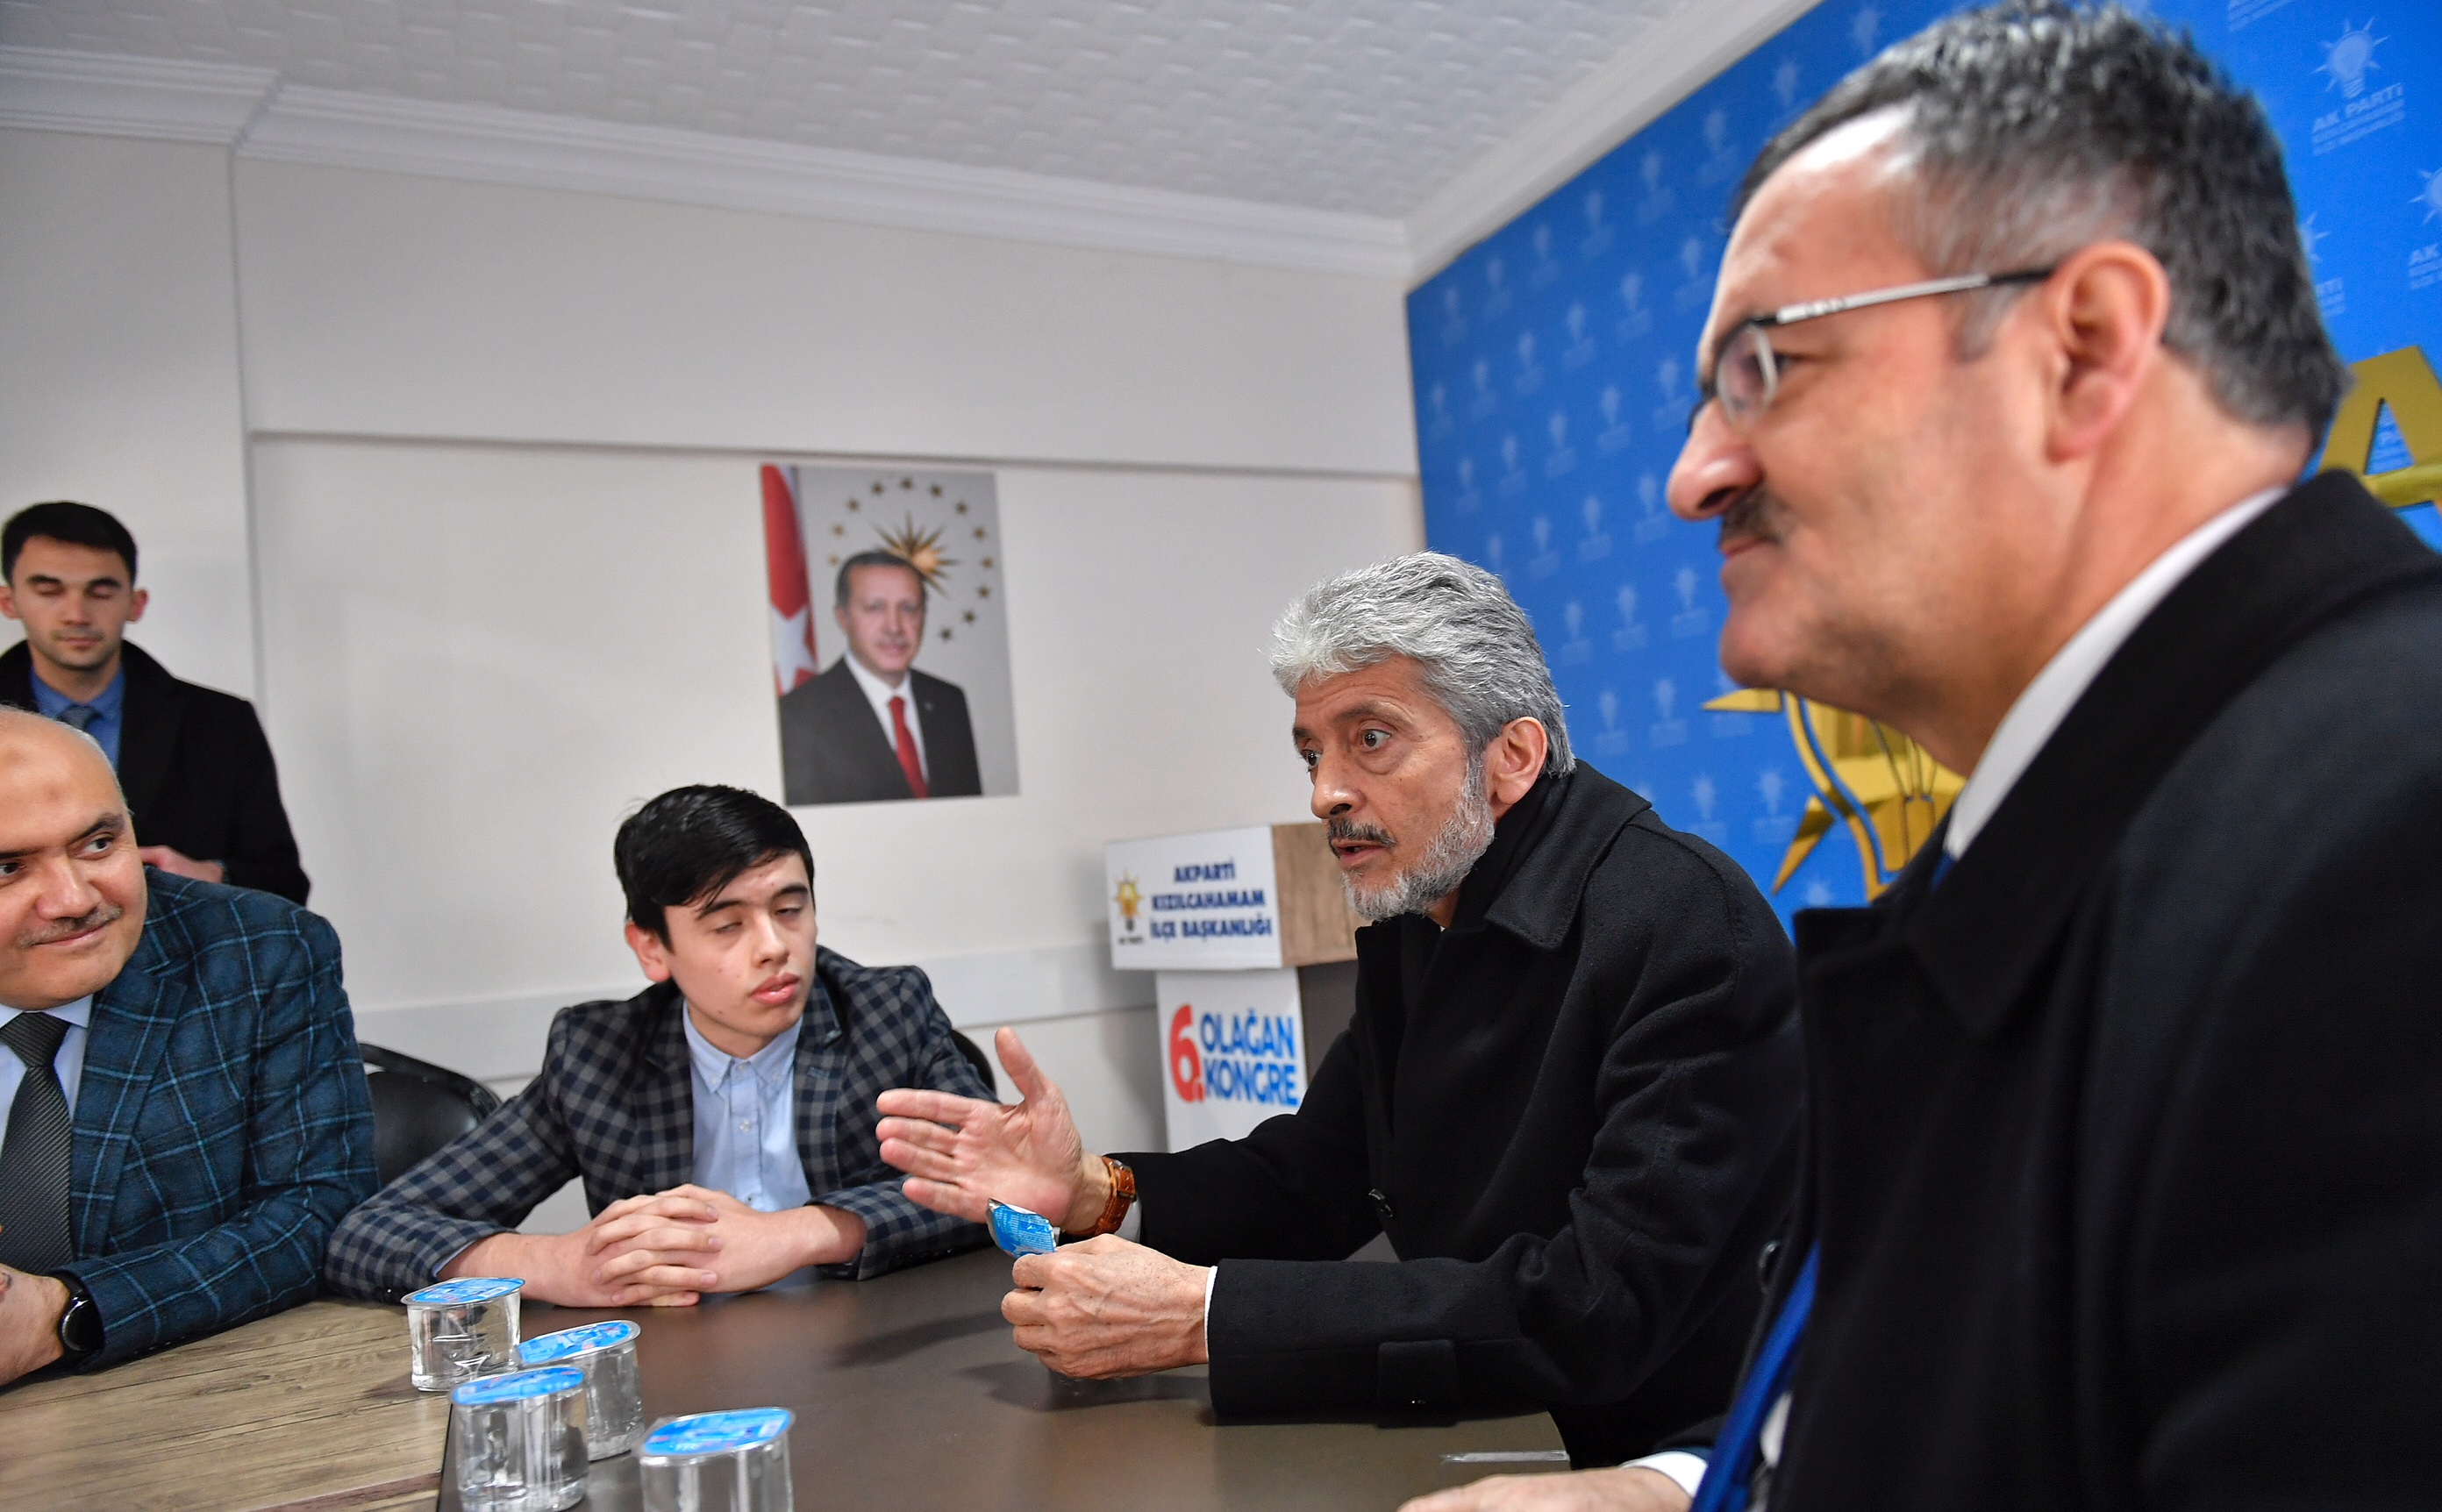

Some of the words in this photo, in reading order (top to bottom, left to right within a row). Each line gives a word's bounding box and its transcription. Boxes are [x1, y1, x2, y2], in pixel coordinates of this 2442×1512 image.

[2311, 111, 2340, 134] AK
[1152, 889, 1266, 910] KIZILCAHAMAM
[1201, 1008, 1296, 1059] OLAĞAN
[1203, 1058, 1299, 1107] KONGRE
